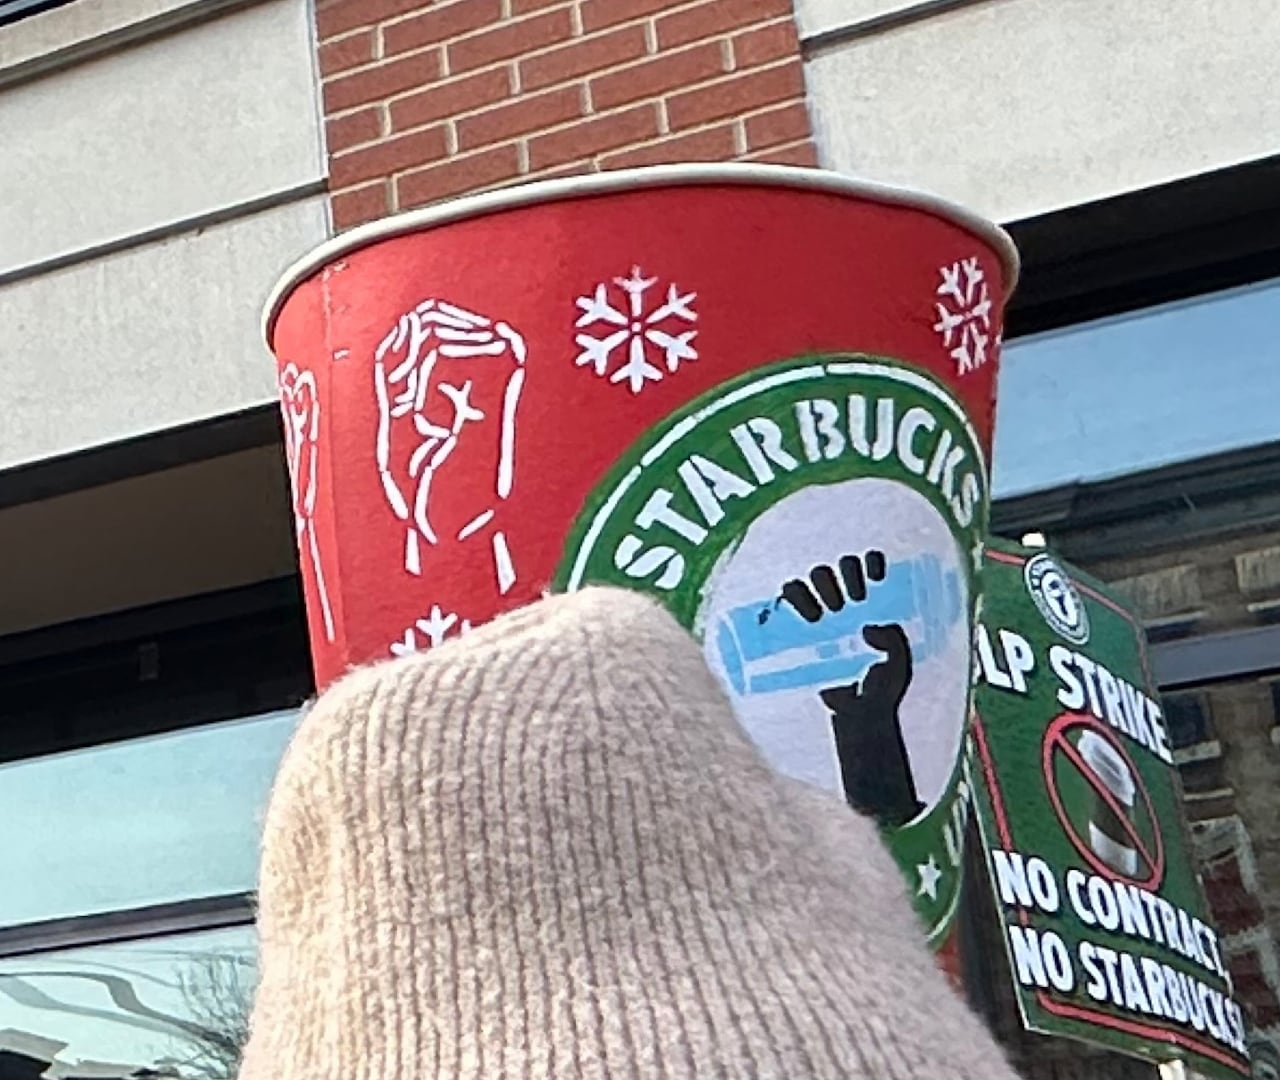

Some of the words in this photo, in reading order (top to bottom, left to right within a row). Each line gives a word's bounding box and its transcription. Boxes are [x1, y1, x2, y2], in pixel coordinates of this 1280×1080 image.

[614, 394, 982, 590] STARBUCKS
[973, 624, 1036, 693] LP
[1049, 645, 1175, 765] STRIKE
[992, 849, 1059, 913] NO
[1066, 869, 1234, 1000] CONTRACT,
[1009, 925, 1075, 992] NO
